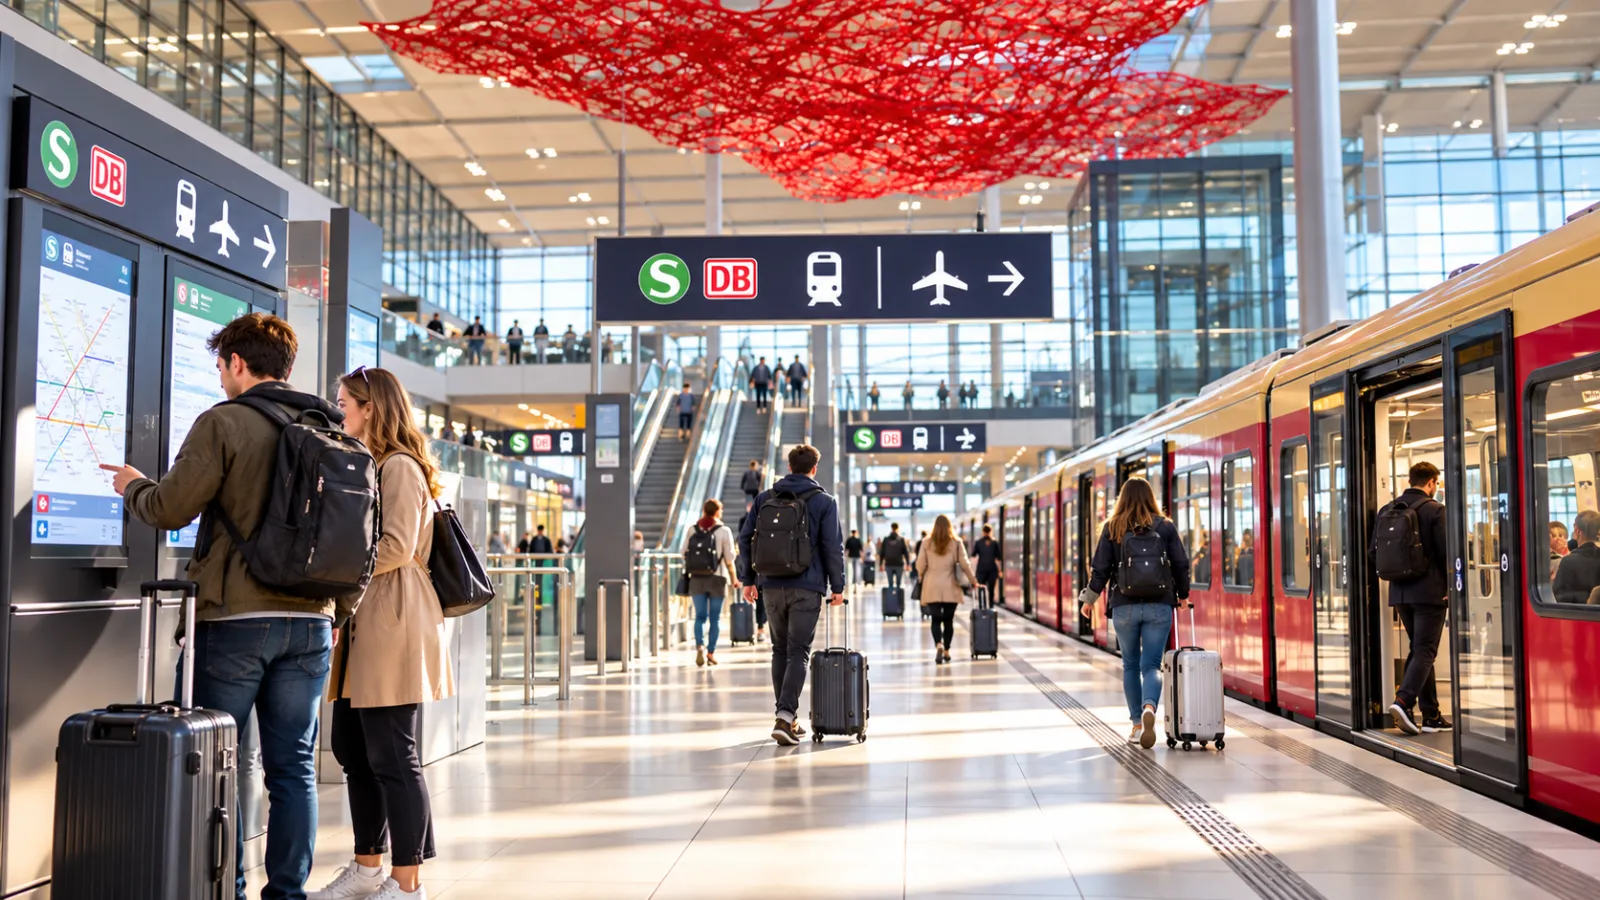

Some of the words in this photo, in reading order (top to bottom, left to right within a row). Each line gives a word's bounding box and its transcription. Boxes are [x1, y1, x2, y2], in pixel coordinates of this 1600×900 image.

[48, 128, 71, 180] S
[96, 155, 122, 196] DB
[648, 258, 681, 299] S
[710, 265, 752, 292] DB
[512, 433, 526, 451] S
[857, 429, 872, 447] S
